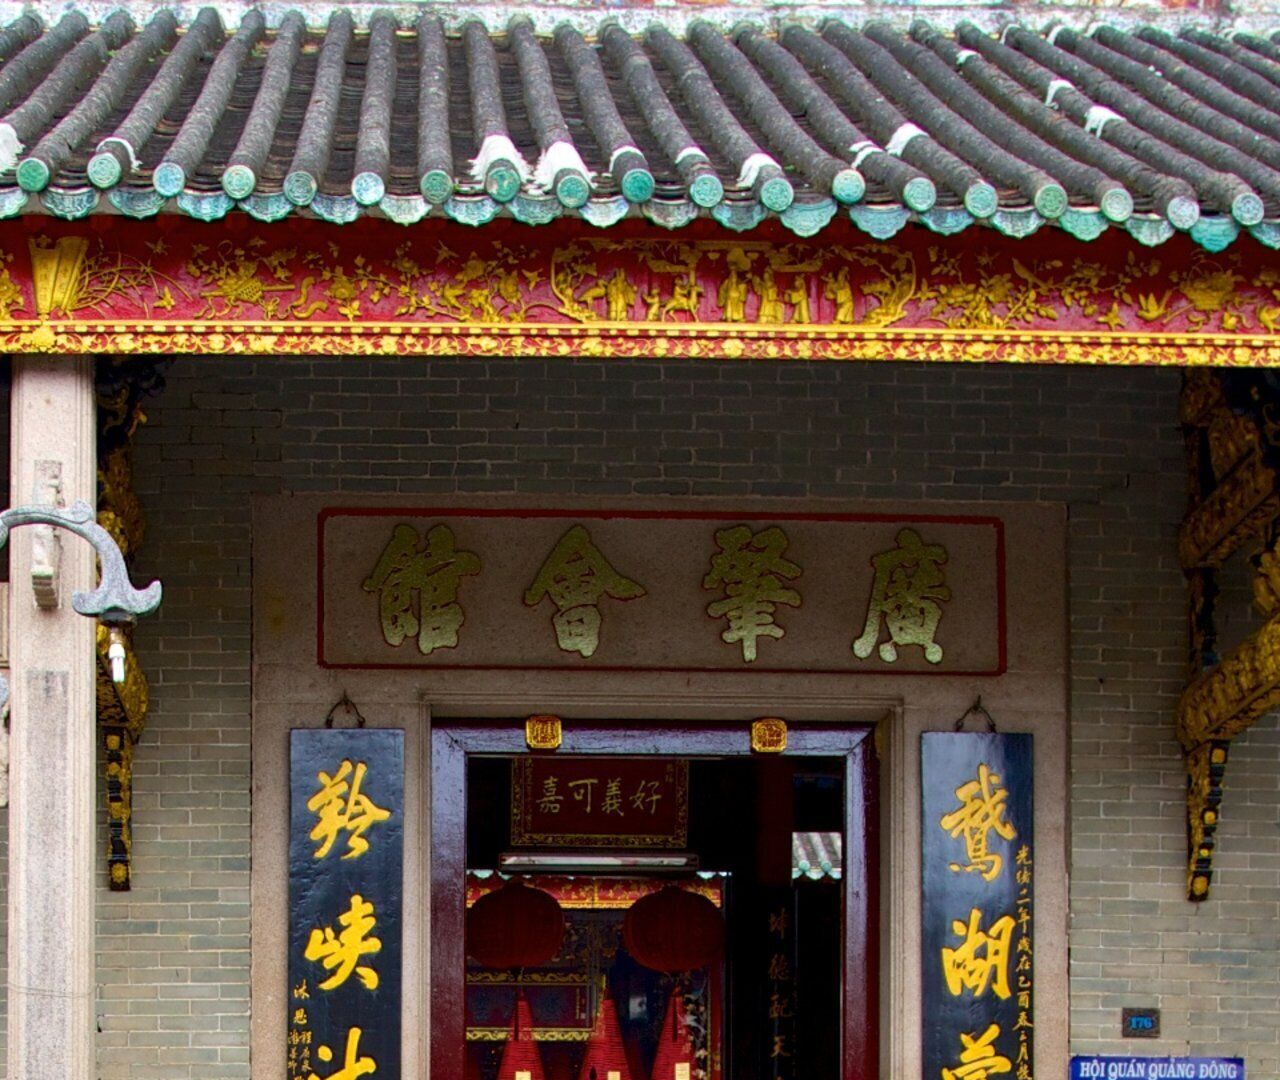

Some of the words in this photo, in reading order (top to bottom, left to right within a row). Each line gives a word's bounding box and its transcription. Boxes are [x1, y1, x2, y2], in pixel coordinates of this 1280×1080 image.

[363, 524, 951, 665] 廣肇會館
[536, 775, 662, 816] 好義可嘉
[1130, 1017, 1153, 1029] 176
[1080, 1059, 1105, 1080] HỘI
[1108, 1059, 1145, 1080] QUÁN
[1148, 1058, 1195, 1080] QUẢNG
[1199, 1060, 1237, 1079] ĐÔNG
